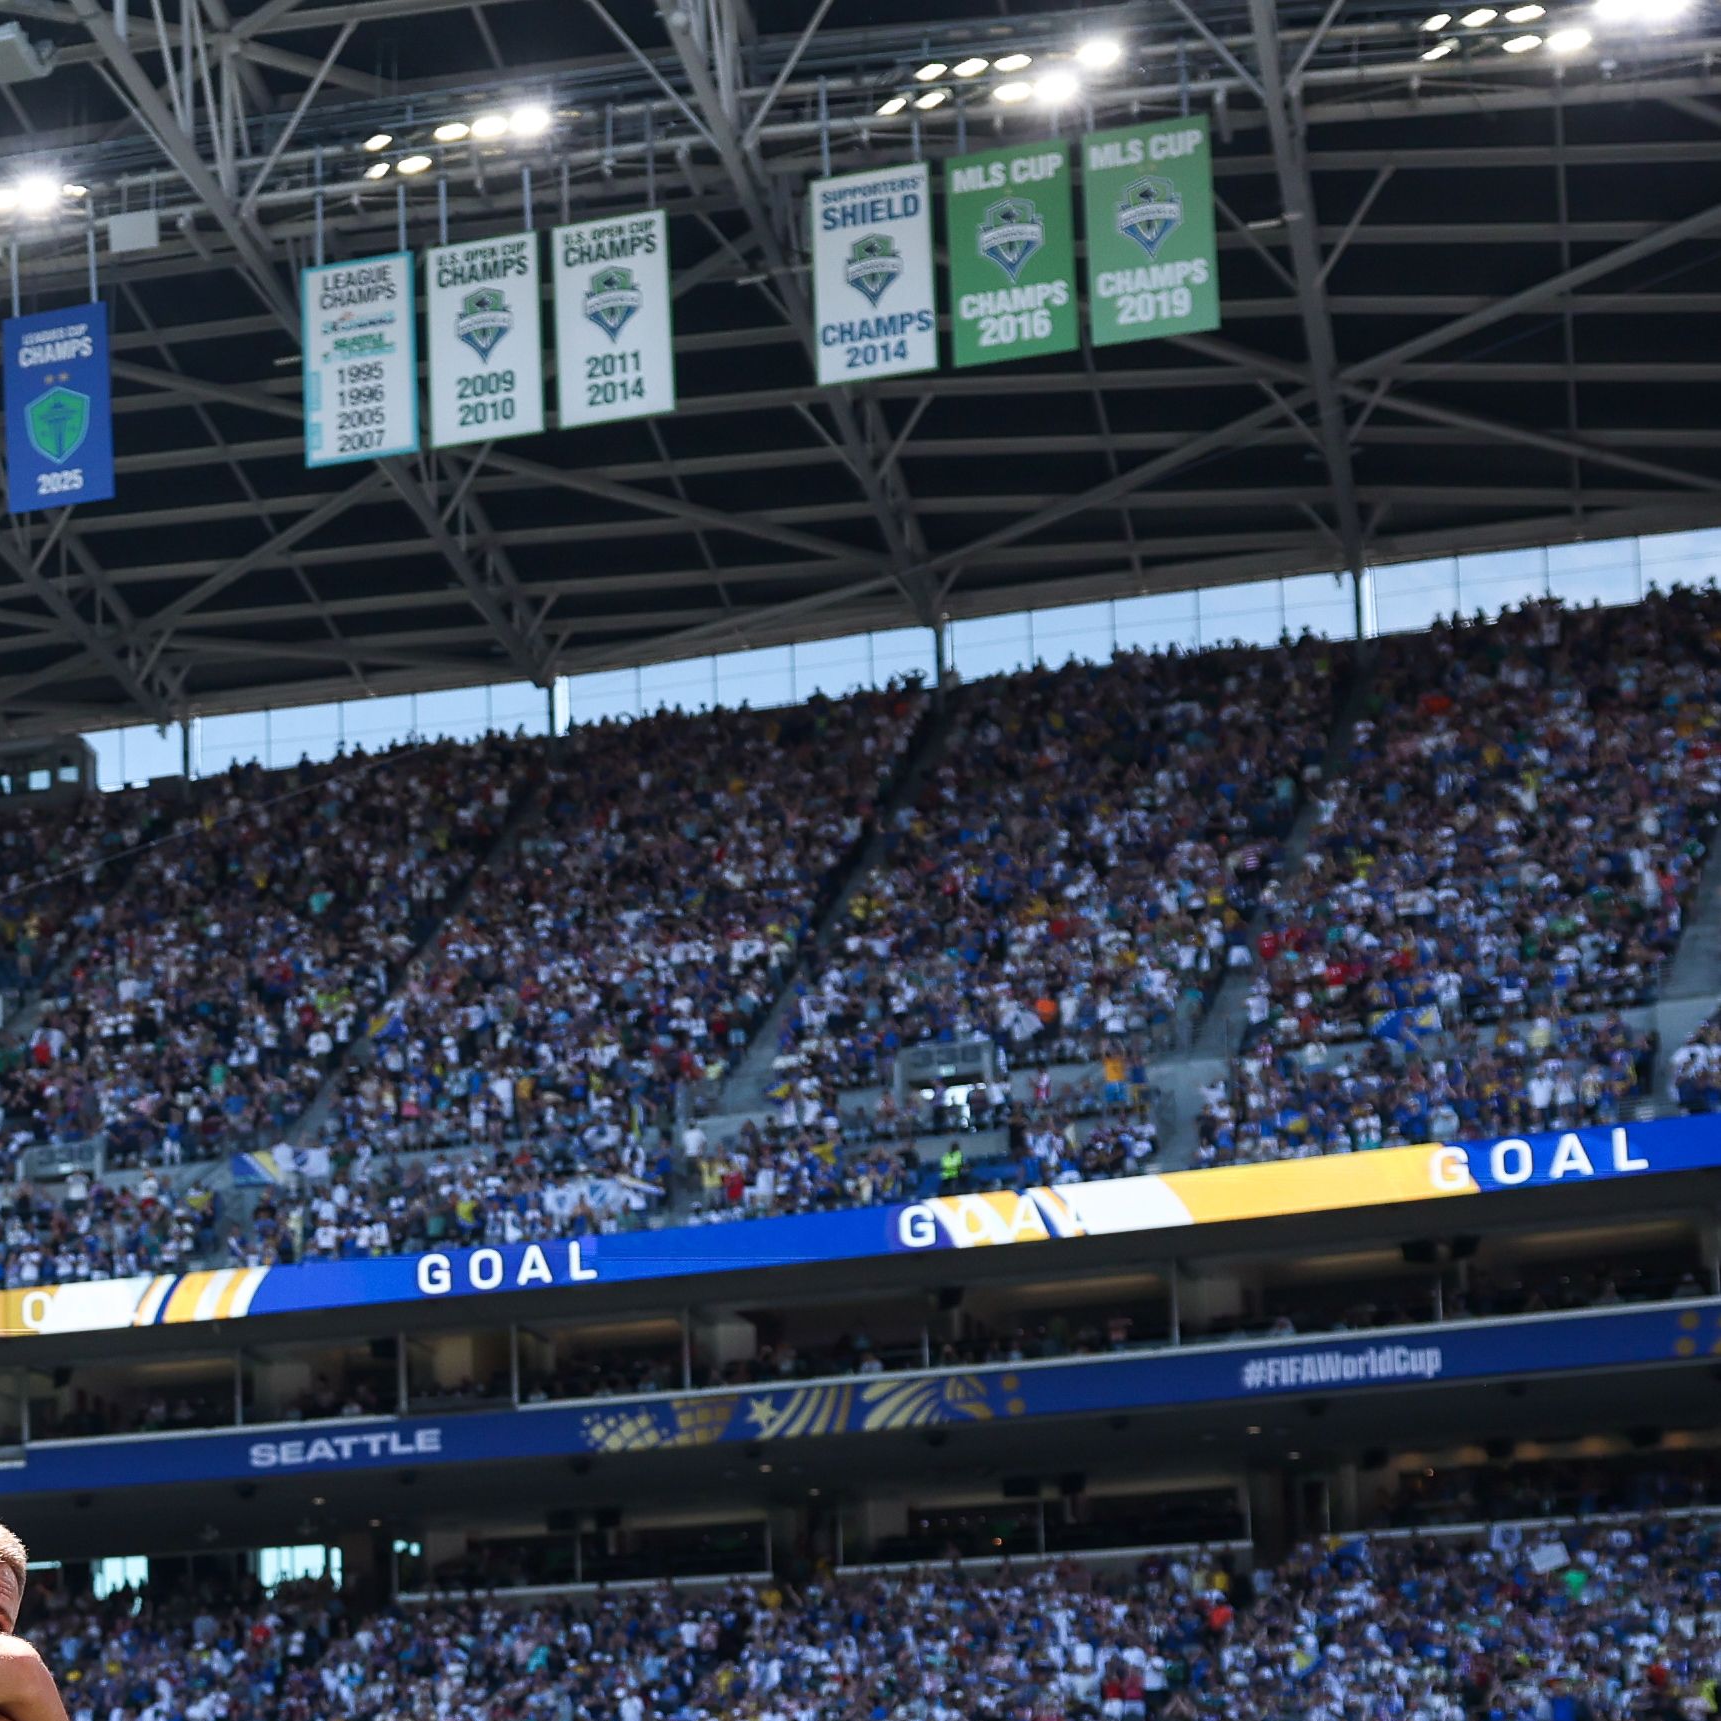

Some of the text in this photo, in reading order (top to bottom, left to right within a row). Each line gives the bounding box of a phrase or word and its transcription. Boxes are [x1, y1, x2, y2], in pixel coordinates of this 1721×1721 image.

[1088, 128, 1204, 171] MLS CUP
[952, 151, 1064, 194] MLS CUP
[822, 194, 920, 232] SHIELD
[563, 233, 657, 268] CHAMPS
[321, 265, 392, 292] LEAGUE
[437, 255, 529, 289] CHAMPS
[1096, 256, 1209, 299] CHAMPS
[319, 284, 397, 311] CHAMPS
[960, 279, 1070, 321] CHAMPS
[1116, 287, 1193, 327] 2019
[821, 309, 933, 347] CHAMPS
[978, 309, 1052, 349] 2016
[18, 336, 93, 368] CHAMPS
[585, 351, 642, 380] 2011
[845, 340, 909, 370] 2014
[456, 369, 515, 401] 2009
[587, 377, 645, 408] 2014
[459, 398, 516, 428] 2010
[37, 468, 84, 495] 2025
[1428, 1127, 1649, 1191] GOAL
[416, 1240, 598, 1295] GOAL
[1240, 1345, 1442, 1390] #FIFAWorldCup
[249, 1427, 443, 1468] SEATTLE
